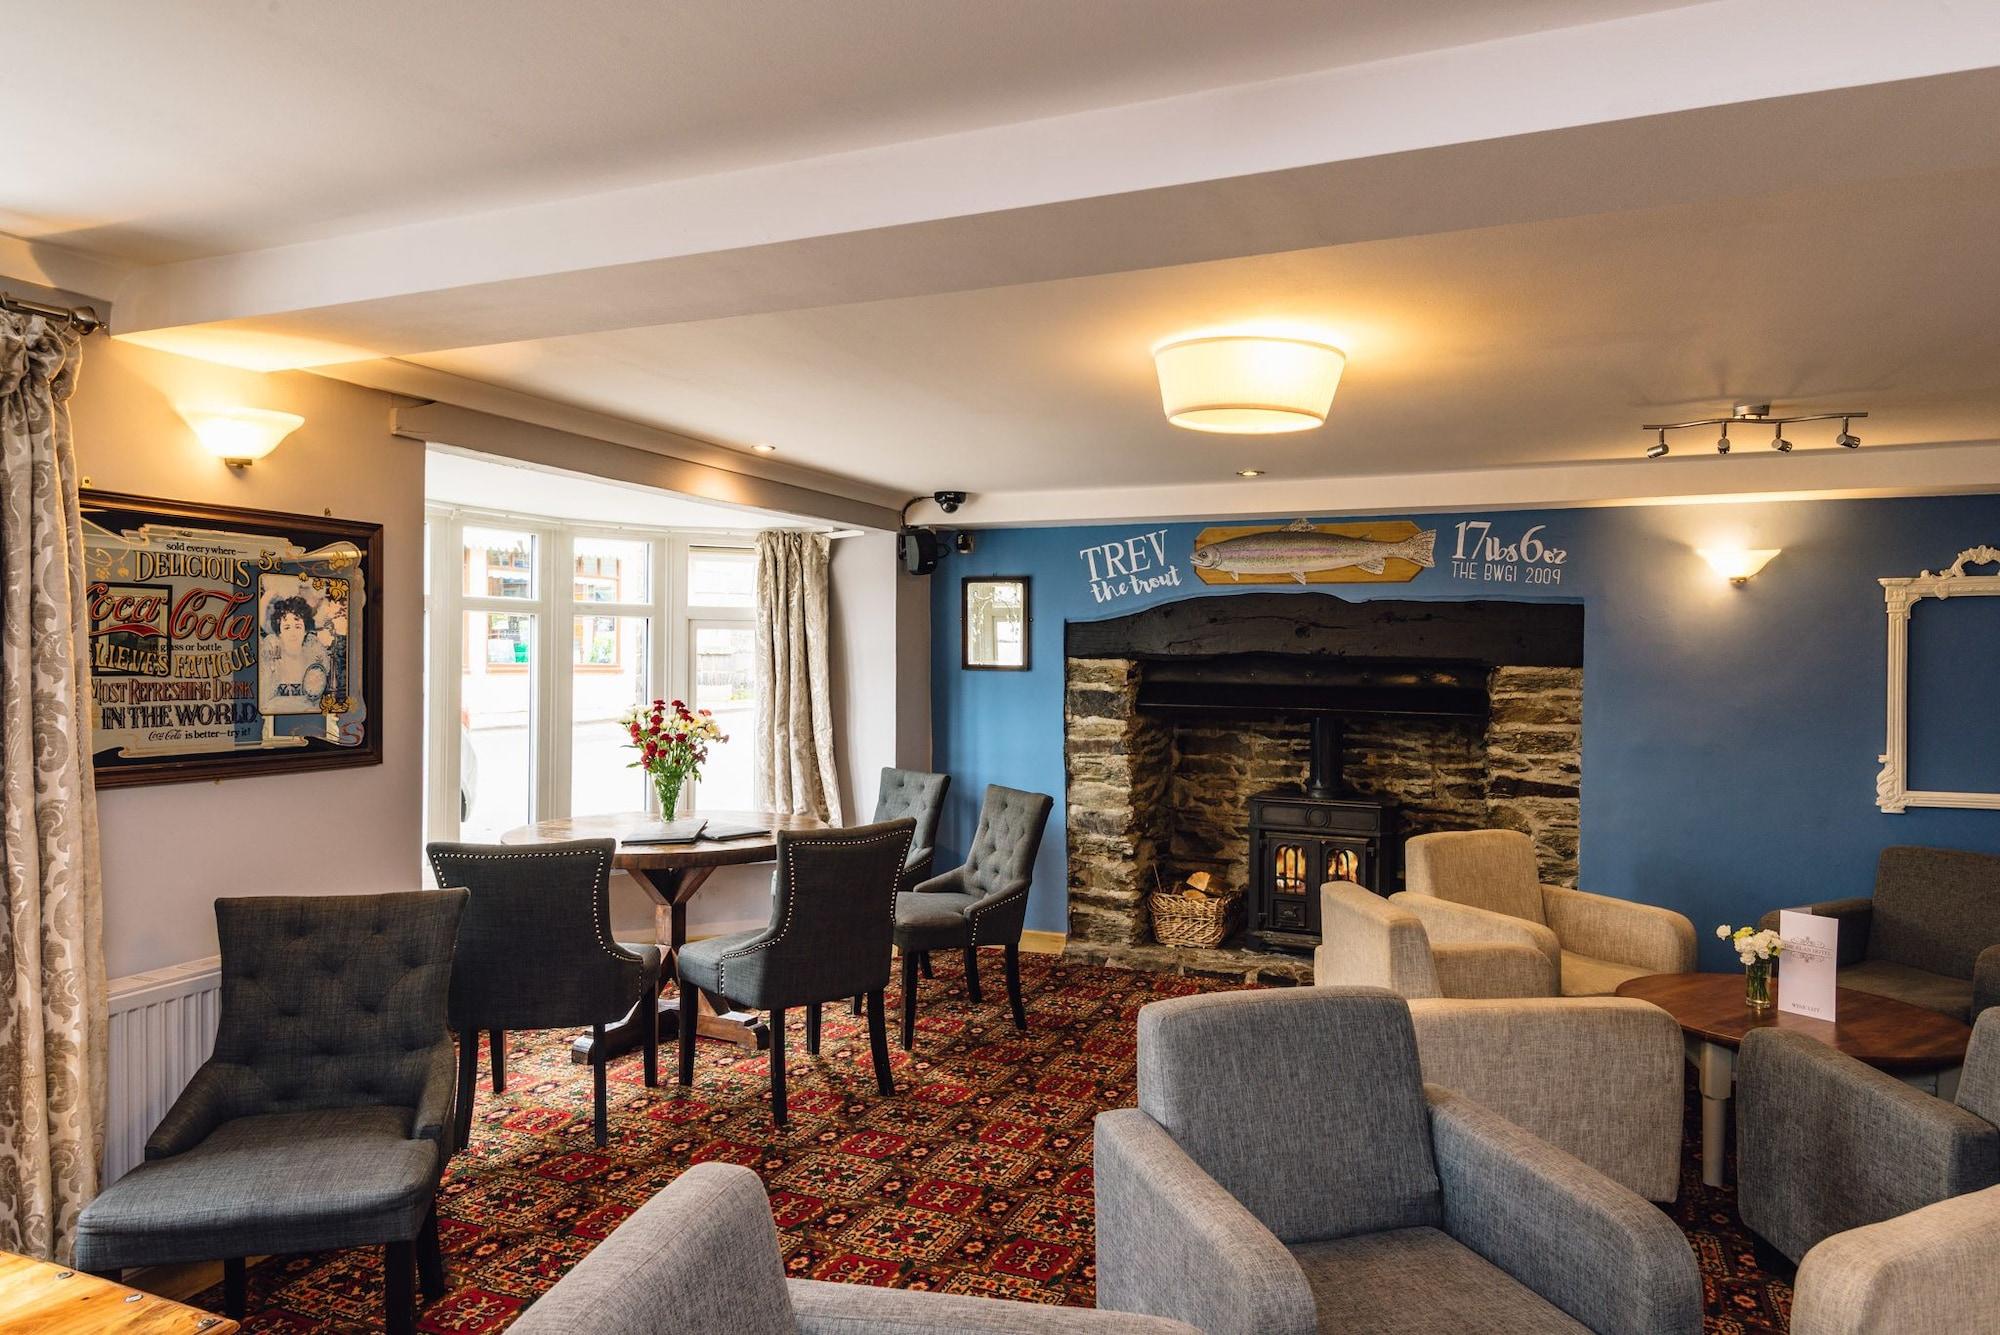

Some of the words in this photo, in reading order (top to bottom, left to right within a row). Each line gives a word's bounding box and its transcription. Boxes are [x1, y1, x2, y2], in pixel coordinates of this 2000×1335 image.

[166, 542, 184, 551] sold
[1080, 529, 1168, 583] TREV
[133, 550, 250, 588] DELICIOUS
[1452, 561, 1478, 580] THE
[1484, 563, 1517, 581] BWGI
[1525, 567, 1561, 585] 2009
[1090, 581, 1129, 604] the
[1129, 565, 1183, 595] trout
[90, 641, 170, 677] LIEVES
[197, 642, 222, 651] bottle
[128, 678, 211, 705] REFRESHING
[212, 677, 255, 702] DRINK
[101, 706, 126, 729] IN
[127, 704, 173, 729] THE
[185, 730, 193, 739] is
